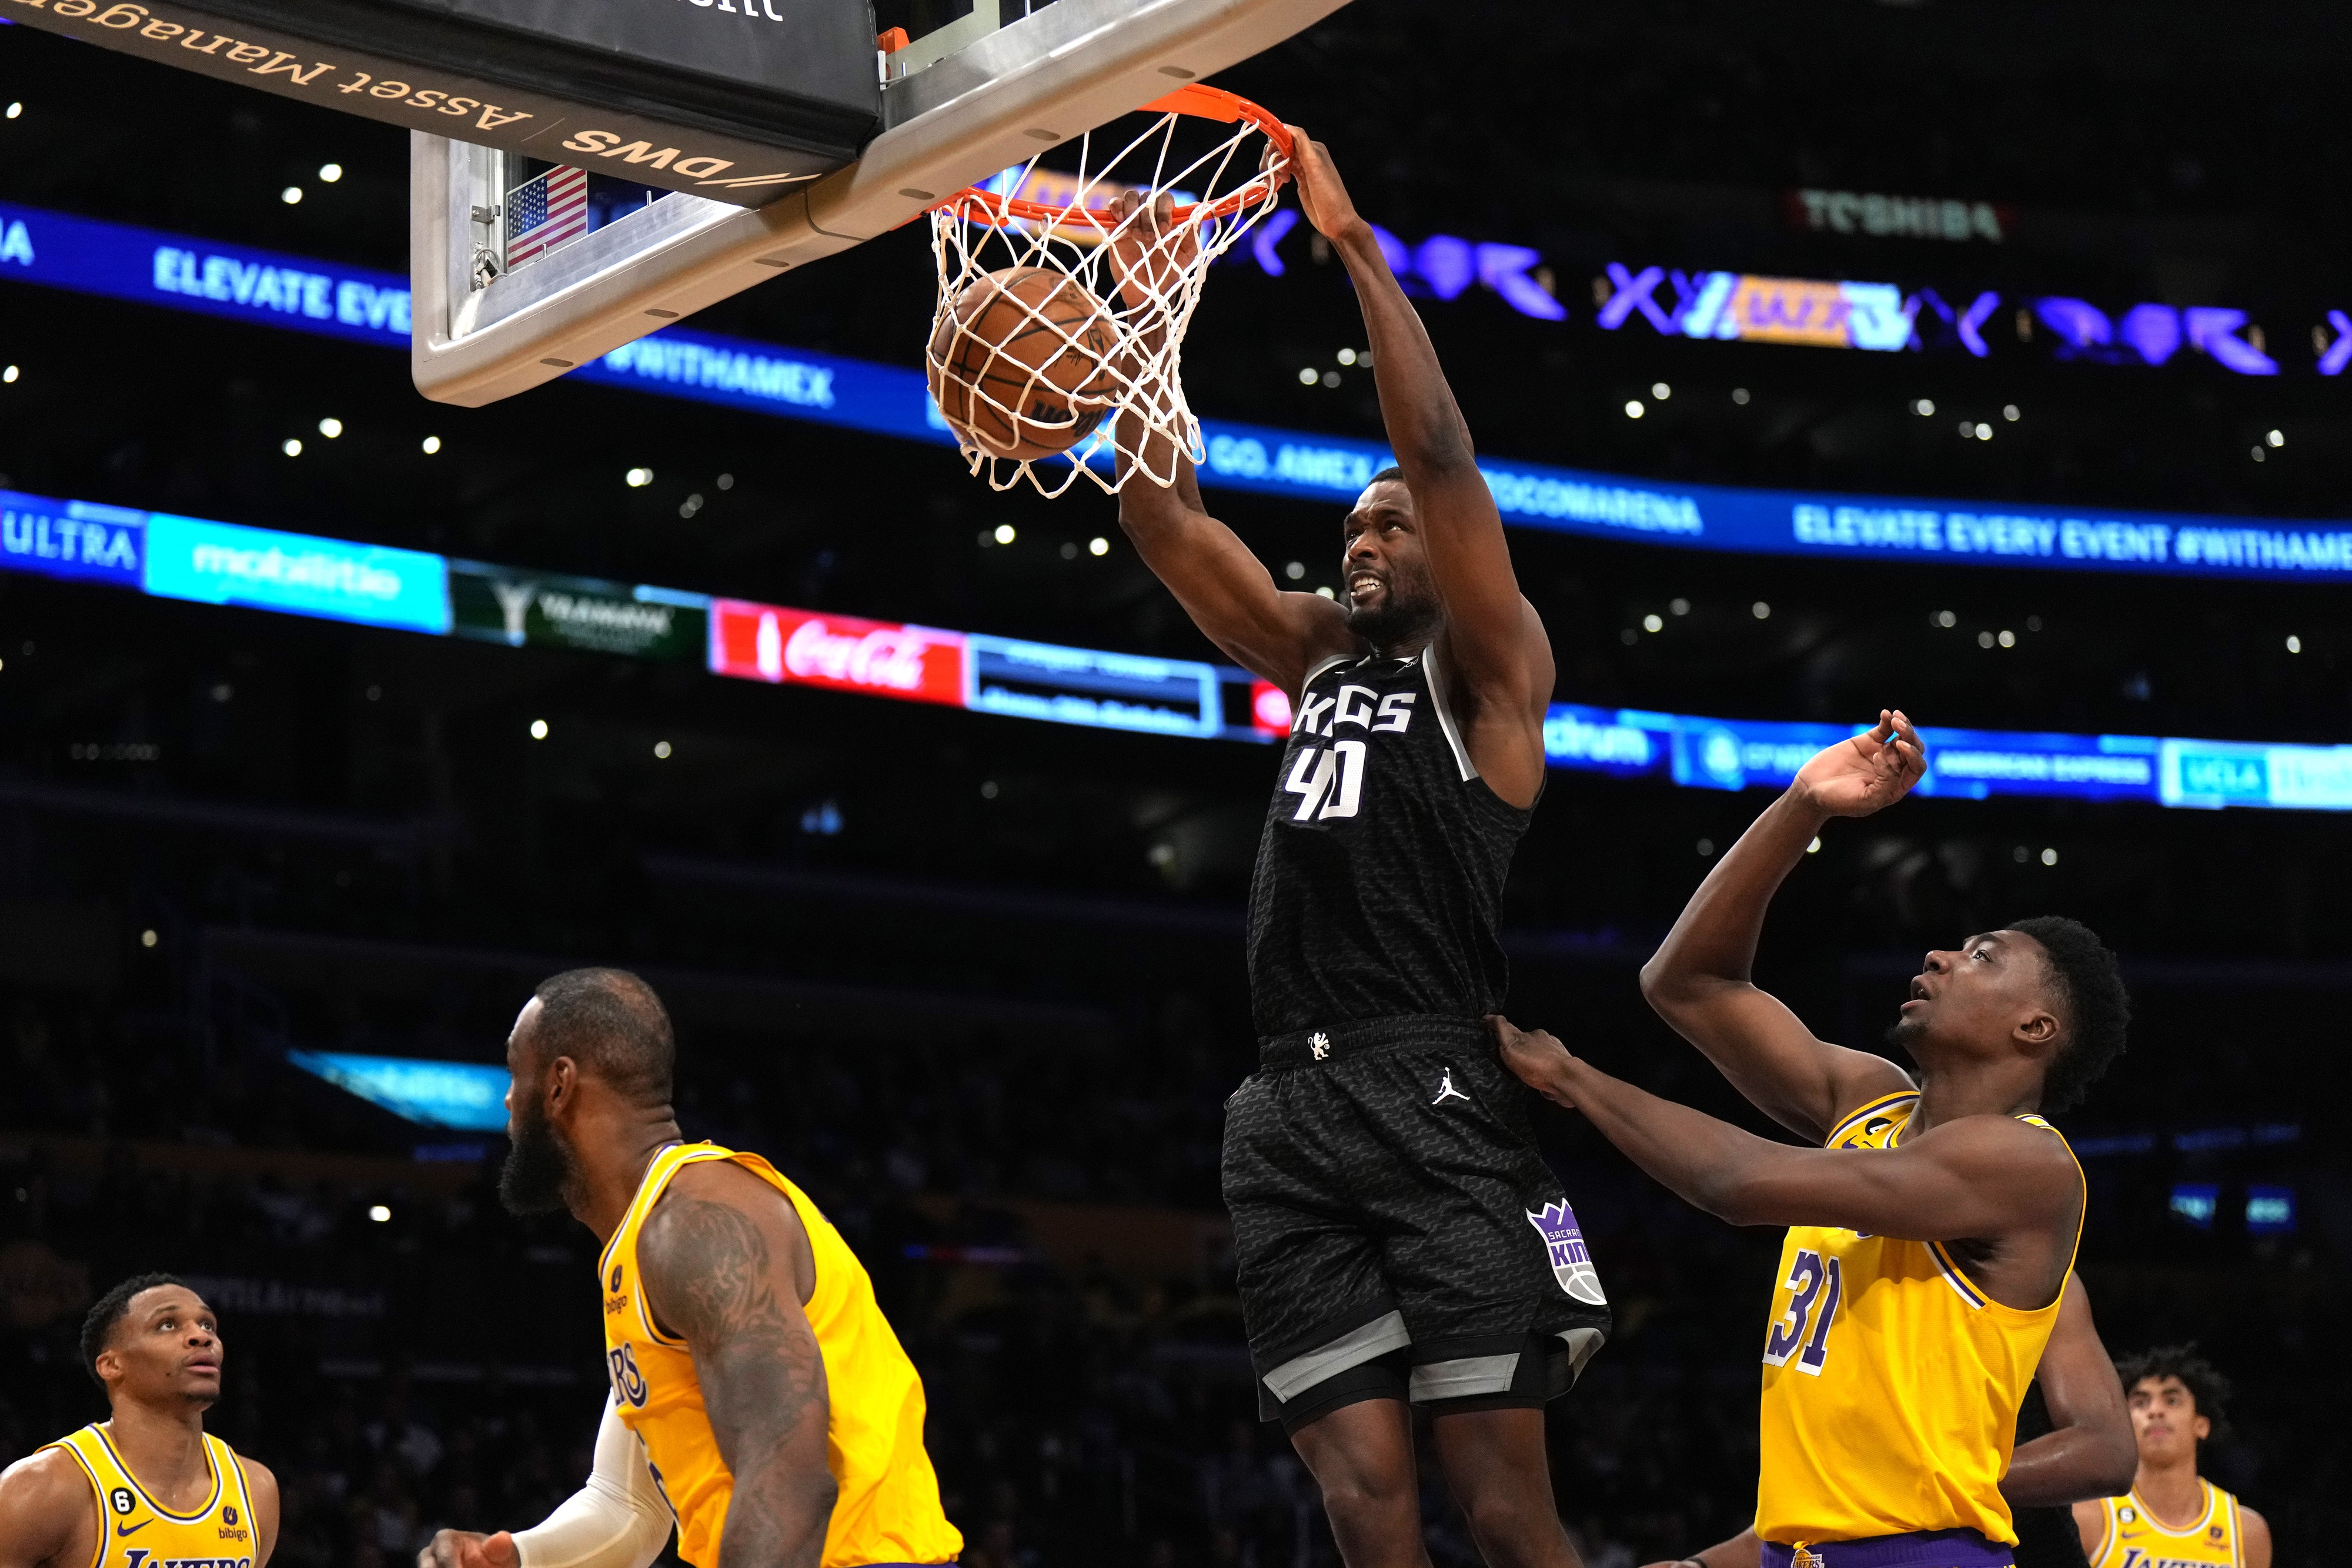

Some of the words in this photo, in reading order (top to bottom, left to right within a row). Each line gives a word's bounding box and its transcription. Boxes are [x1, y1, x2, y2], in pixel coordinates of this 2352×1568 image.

[337, 72, 533, 131] Asset
[562, 130, 734, 179] DWS
[153, 246, 333, 319] ELEVATE
[337, 279, 412, 335] EVE
[2, 510, 136, 570] ULTRA
[1792, 503, 1942, 551] ELEVATE
[1945, 511, 2057, 557] EVERY
[2059, 517, 2170, 563] EVENT
[1292, 684, 1416, 738] KGS
[1284, 740, 1367, 821] 40
[1550, 1242, 1592, 1266] KIN
[1762, 1247, 1841, 1377] 31
[114, 1490, 131, 1513] 6
[218, 1528, 248, 1542] bibigo
